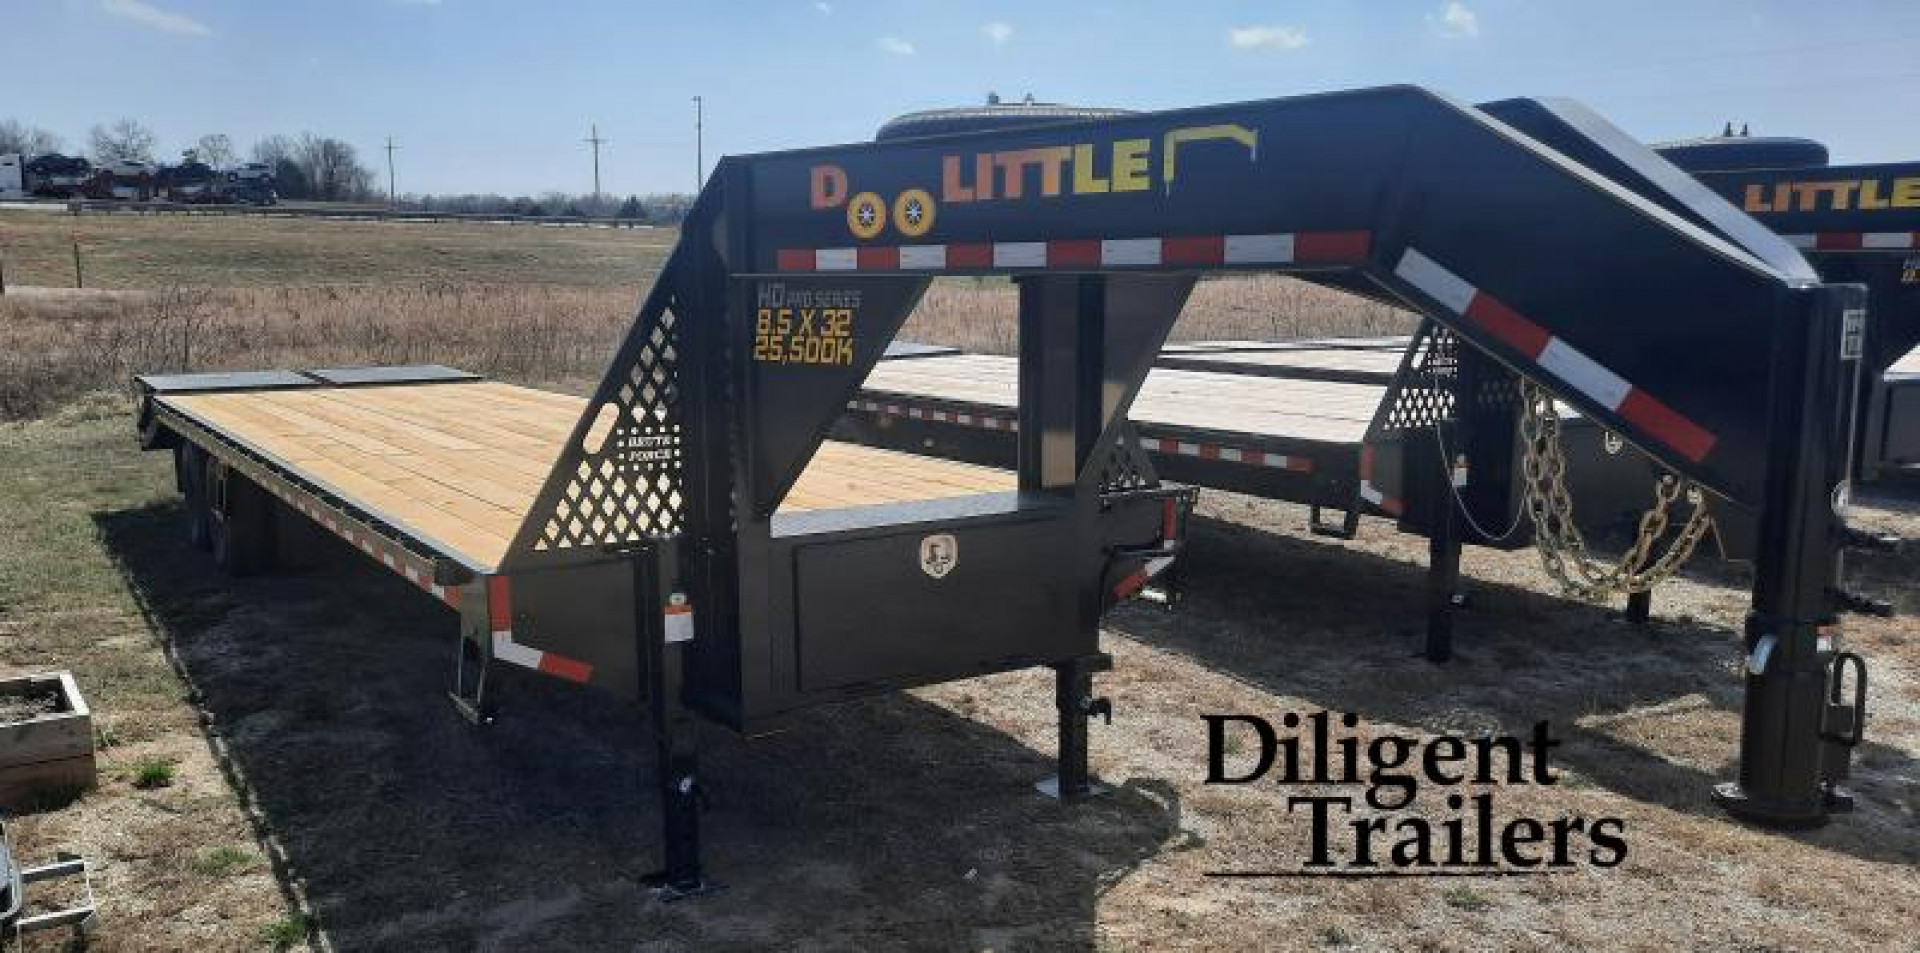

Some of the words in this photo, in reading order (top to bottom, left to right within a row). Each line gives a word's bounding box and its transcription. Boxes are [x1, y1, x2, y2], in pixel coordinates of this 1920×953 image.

[1745, 178, 1920, 212] LITTLE
[756, 308, 793, 335] 8.5
[799, 309, 816, 336] X
[820, 309, 853, 337] 32
[754, 335, 853, 365] 25,500K
